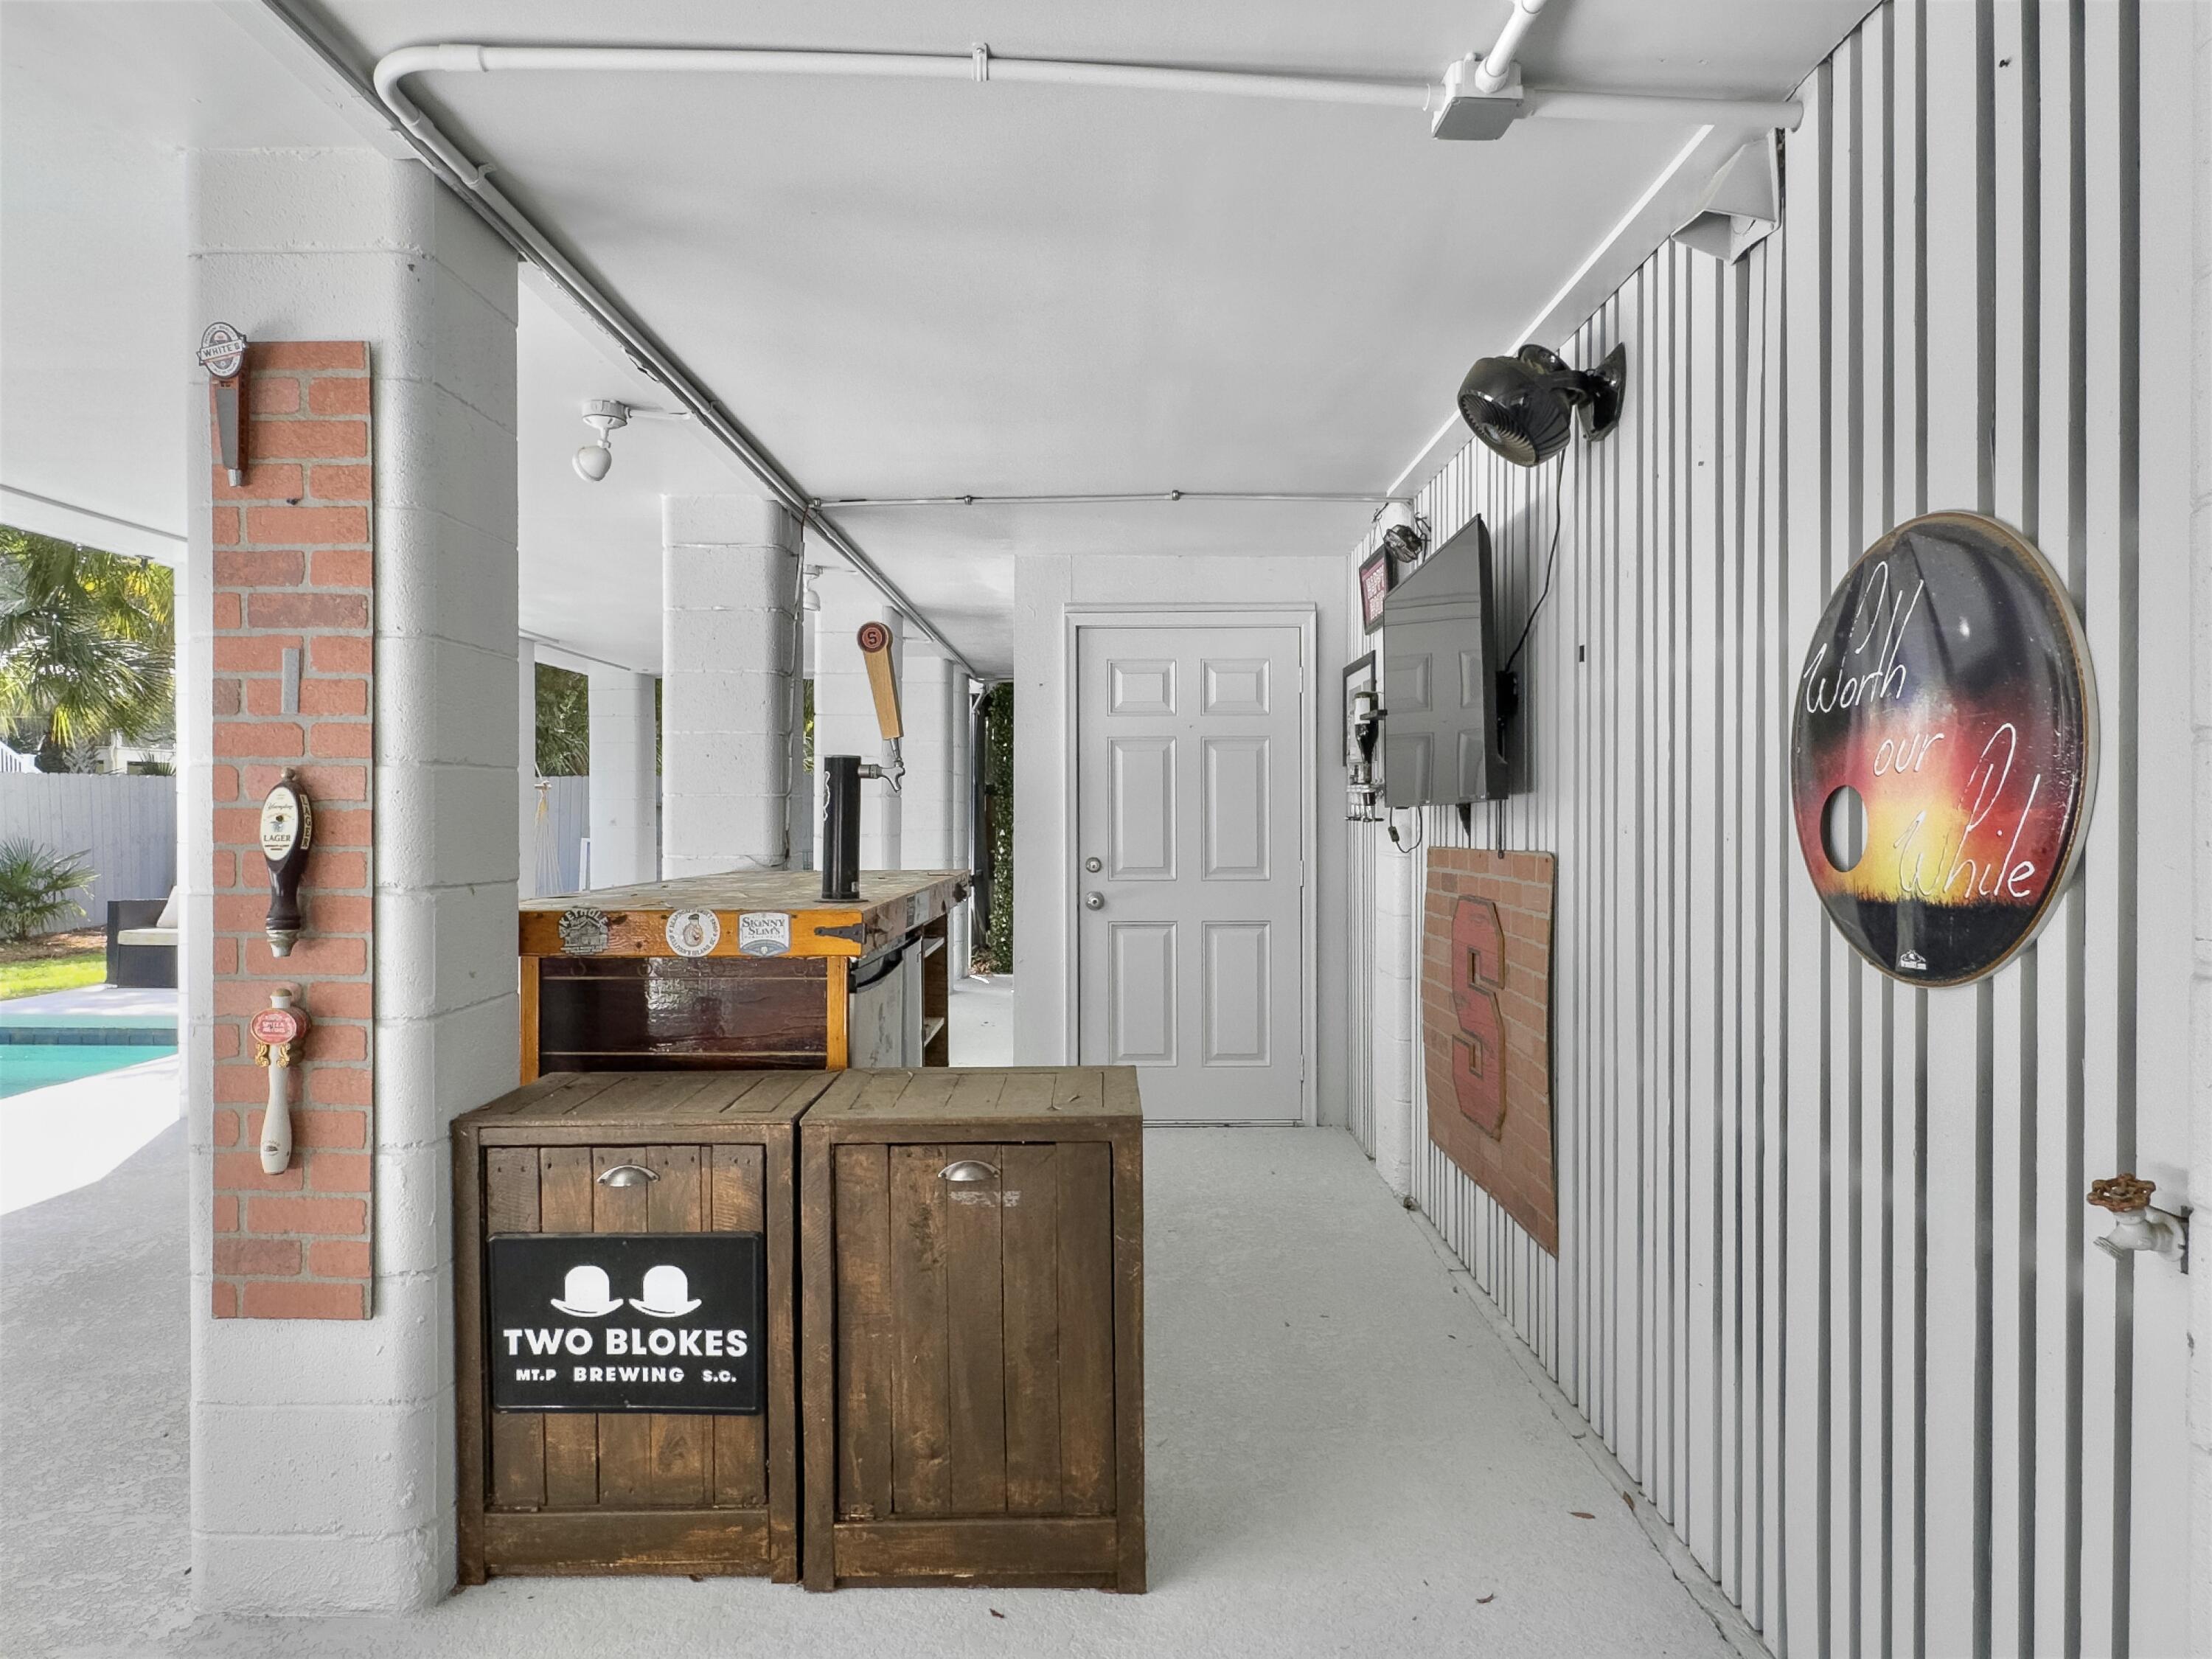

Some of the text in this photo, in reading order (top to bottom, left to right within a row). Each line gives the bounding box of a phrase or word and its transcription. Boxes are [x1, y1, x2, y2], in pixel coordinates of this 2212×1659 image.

[1873, 732, 1944, 776] our
[300, 796, 312, 847] LAGER
[558, 908, 608, 928] KEYHOLE
[503, 1328, 748, 1357] TWO BLOKES
[515, 1366, 737, 1382] MT.P BREWING S.C.
